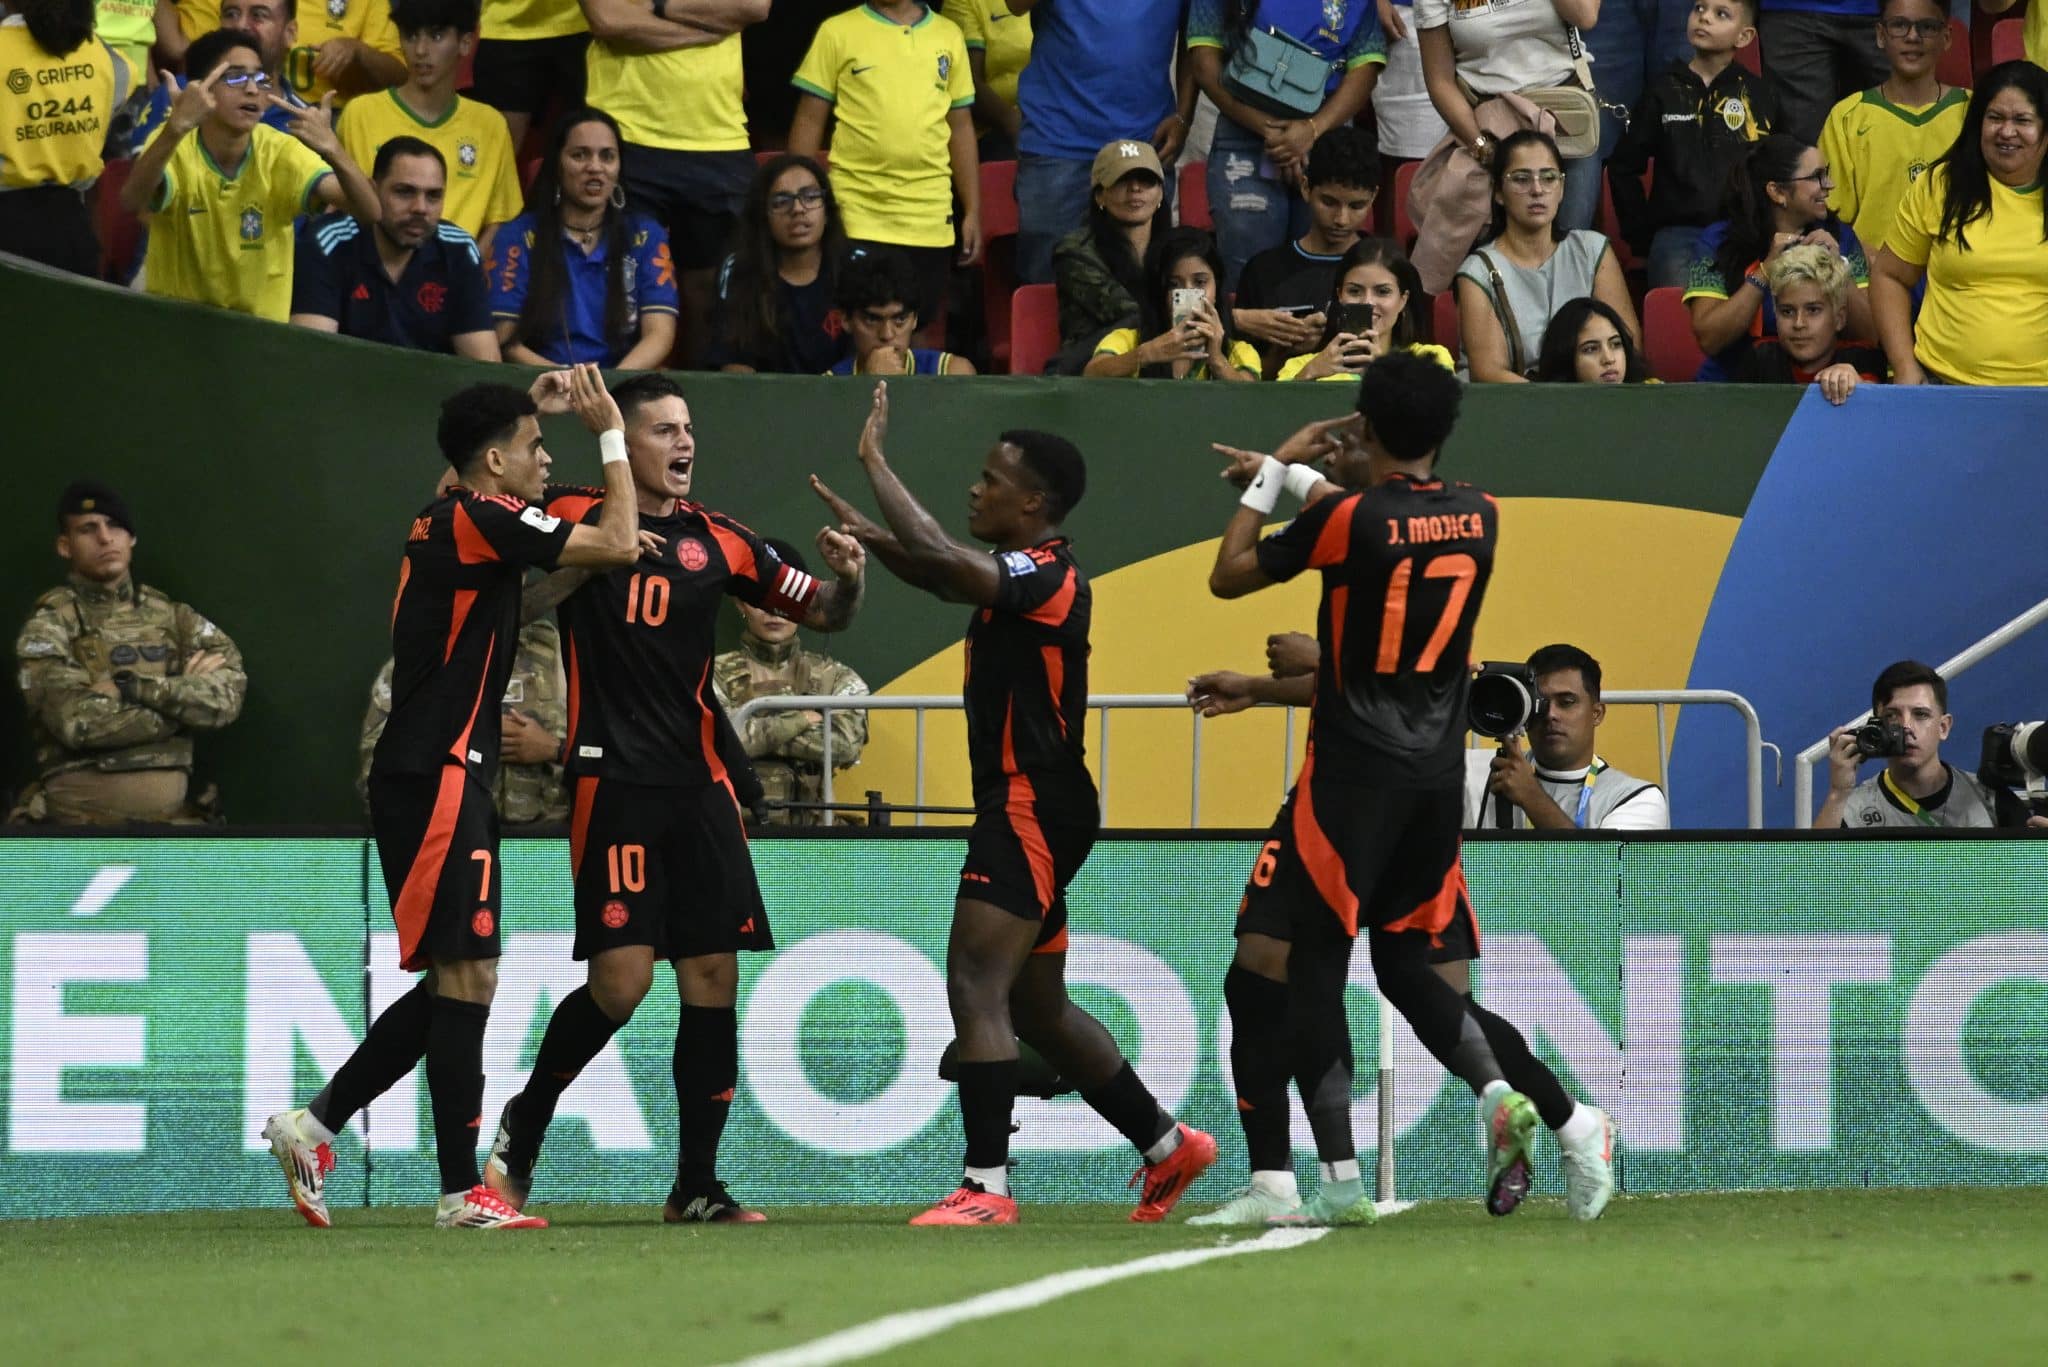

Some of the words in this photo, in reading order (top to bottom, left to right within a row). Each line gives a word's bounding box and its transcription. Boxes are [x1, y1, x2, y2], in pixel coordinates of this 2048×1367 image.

[1568, 26, 1580, 57] COAC
[37, 63, 95, 86] GRIFFO
[27, 96, 94, 121] 0244
[1387, 519, 1405, 545] J.
[1408, 513, 1484, 544] MOJICA
[625, 572, 671, 627] 10
[1375, 553, 1478, 673] 17
[470, 849, 492, 901] 7
[608, 844, 646, 893] 10
[1253, 840, 1282, 887] 6
[7, 865, 150, 1151] É
